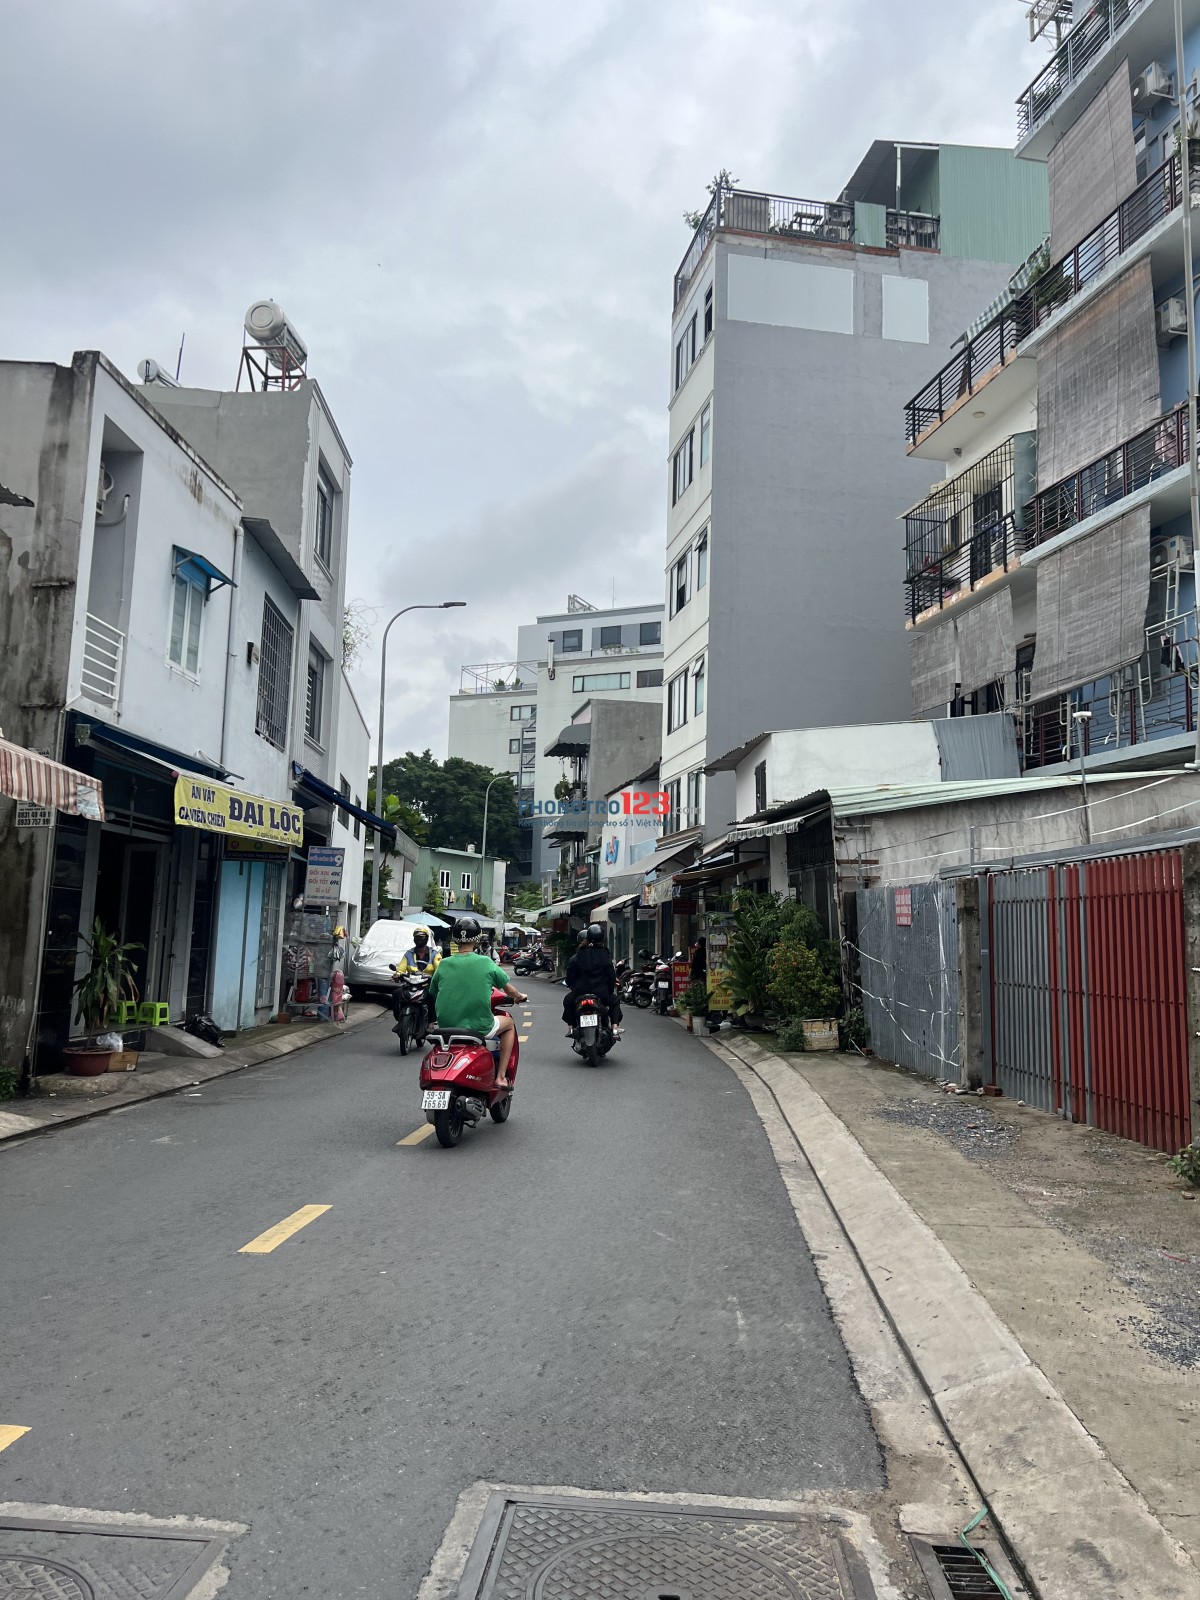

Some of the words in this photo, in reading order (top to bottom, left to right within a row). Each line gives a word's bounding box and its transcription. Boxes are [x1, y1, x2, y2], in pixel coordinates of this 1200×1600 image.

[229, 796, 265, 829] ĐẠI
[269, 806, 301, 836] LỘC
[426, 1091, 446, 1100] 59-SA
